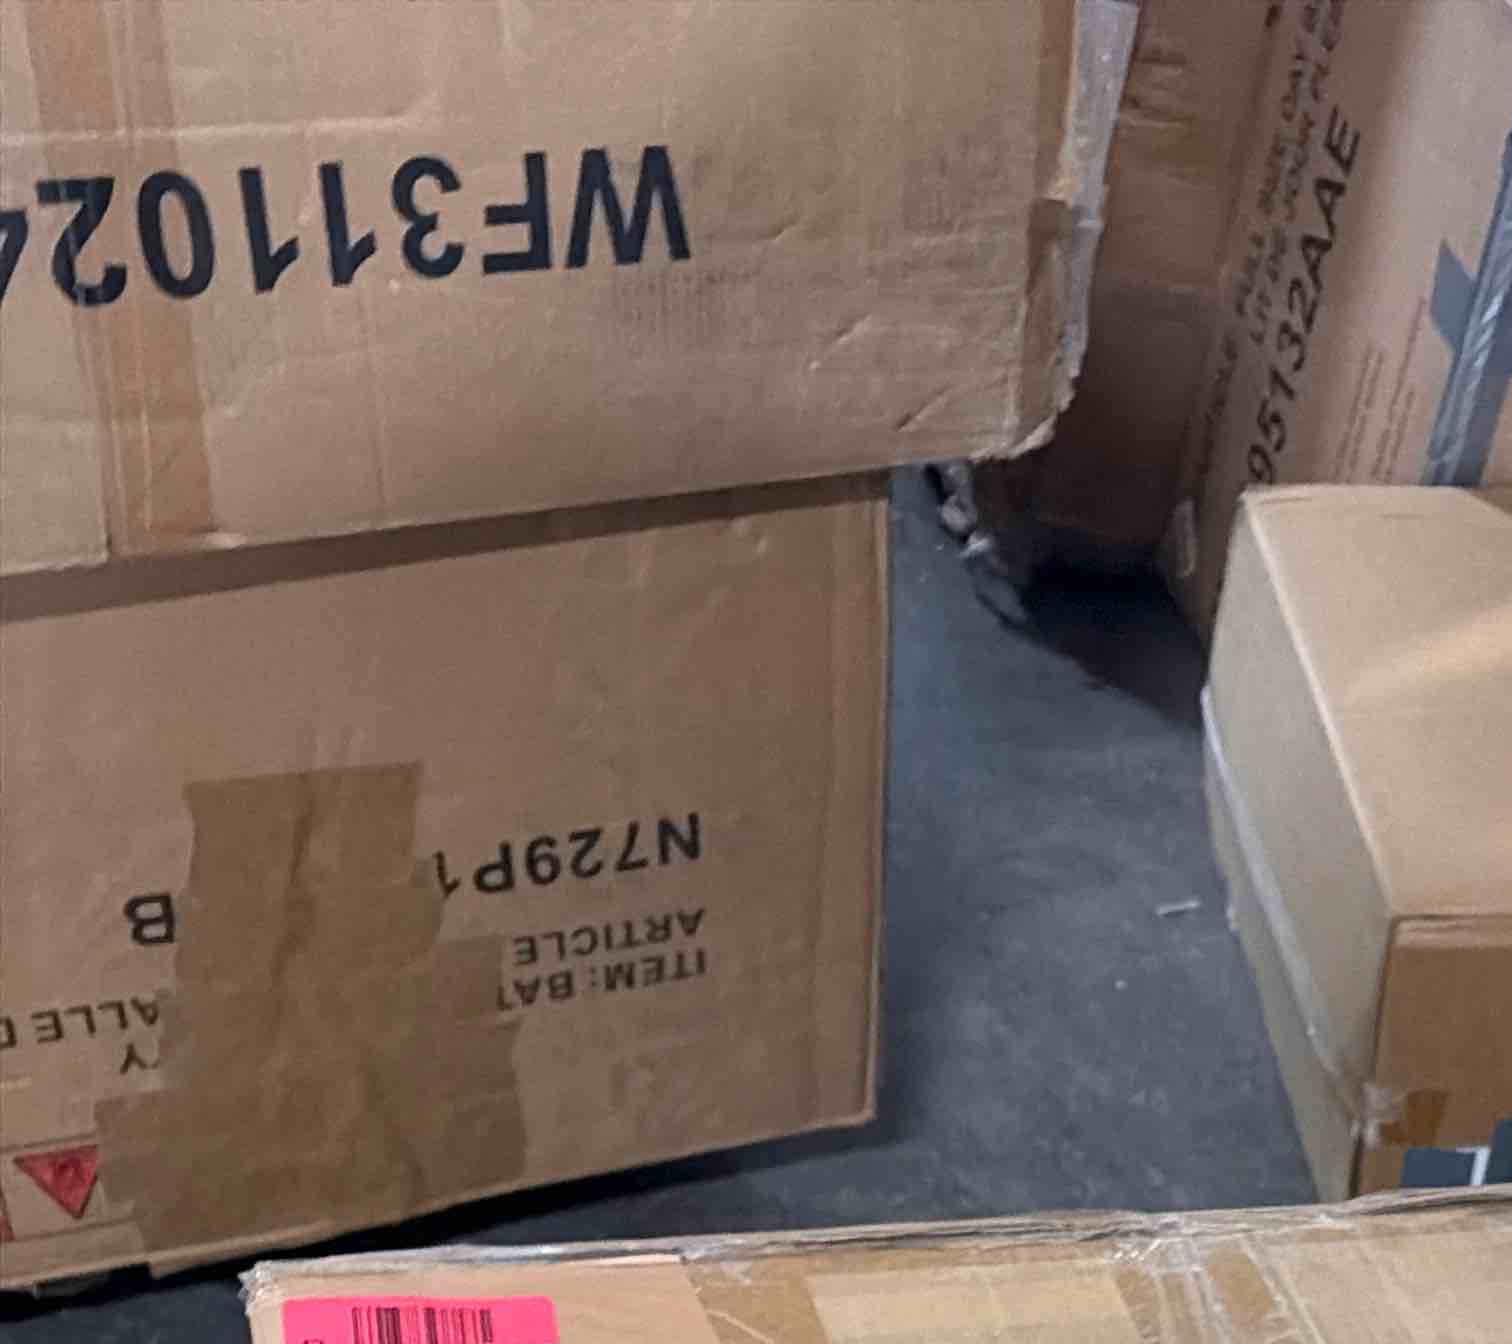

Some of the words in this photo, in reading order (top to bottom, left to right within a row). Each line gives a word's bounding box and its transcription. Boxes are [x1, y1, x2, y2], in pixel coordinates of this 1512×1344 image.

[434, 812, 703, 900] N729P1
[512, 906, 706, 966] ARTICLE
[588, 949, 708, 995] ITEM:
